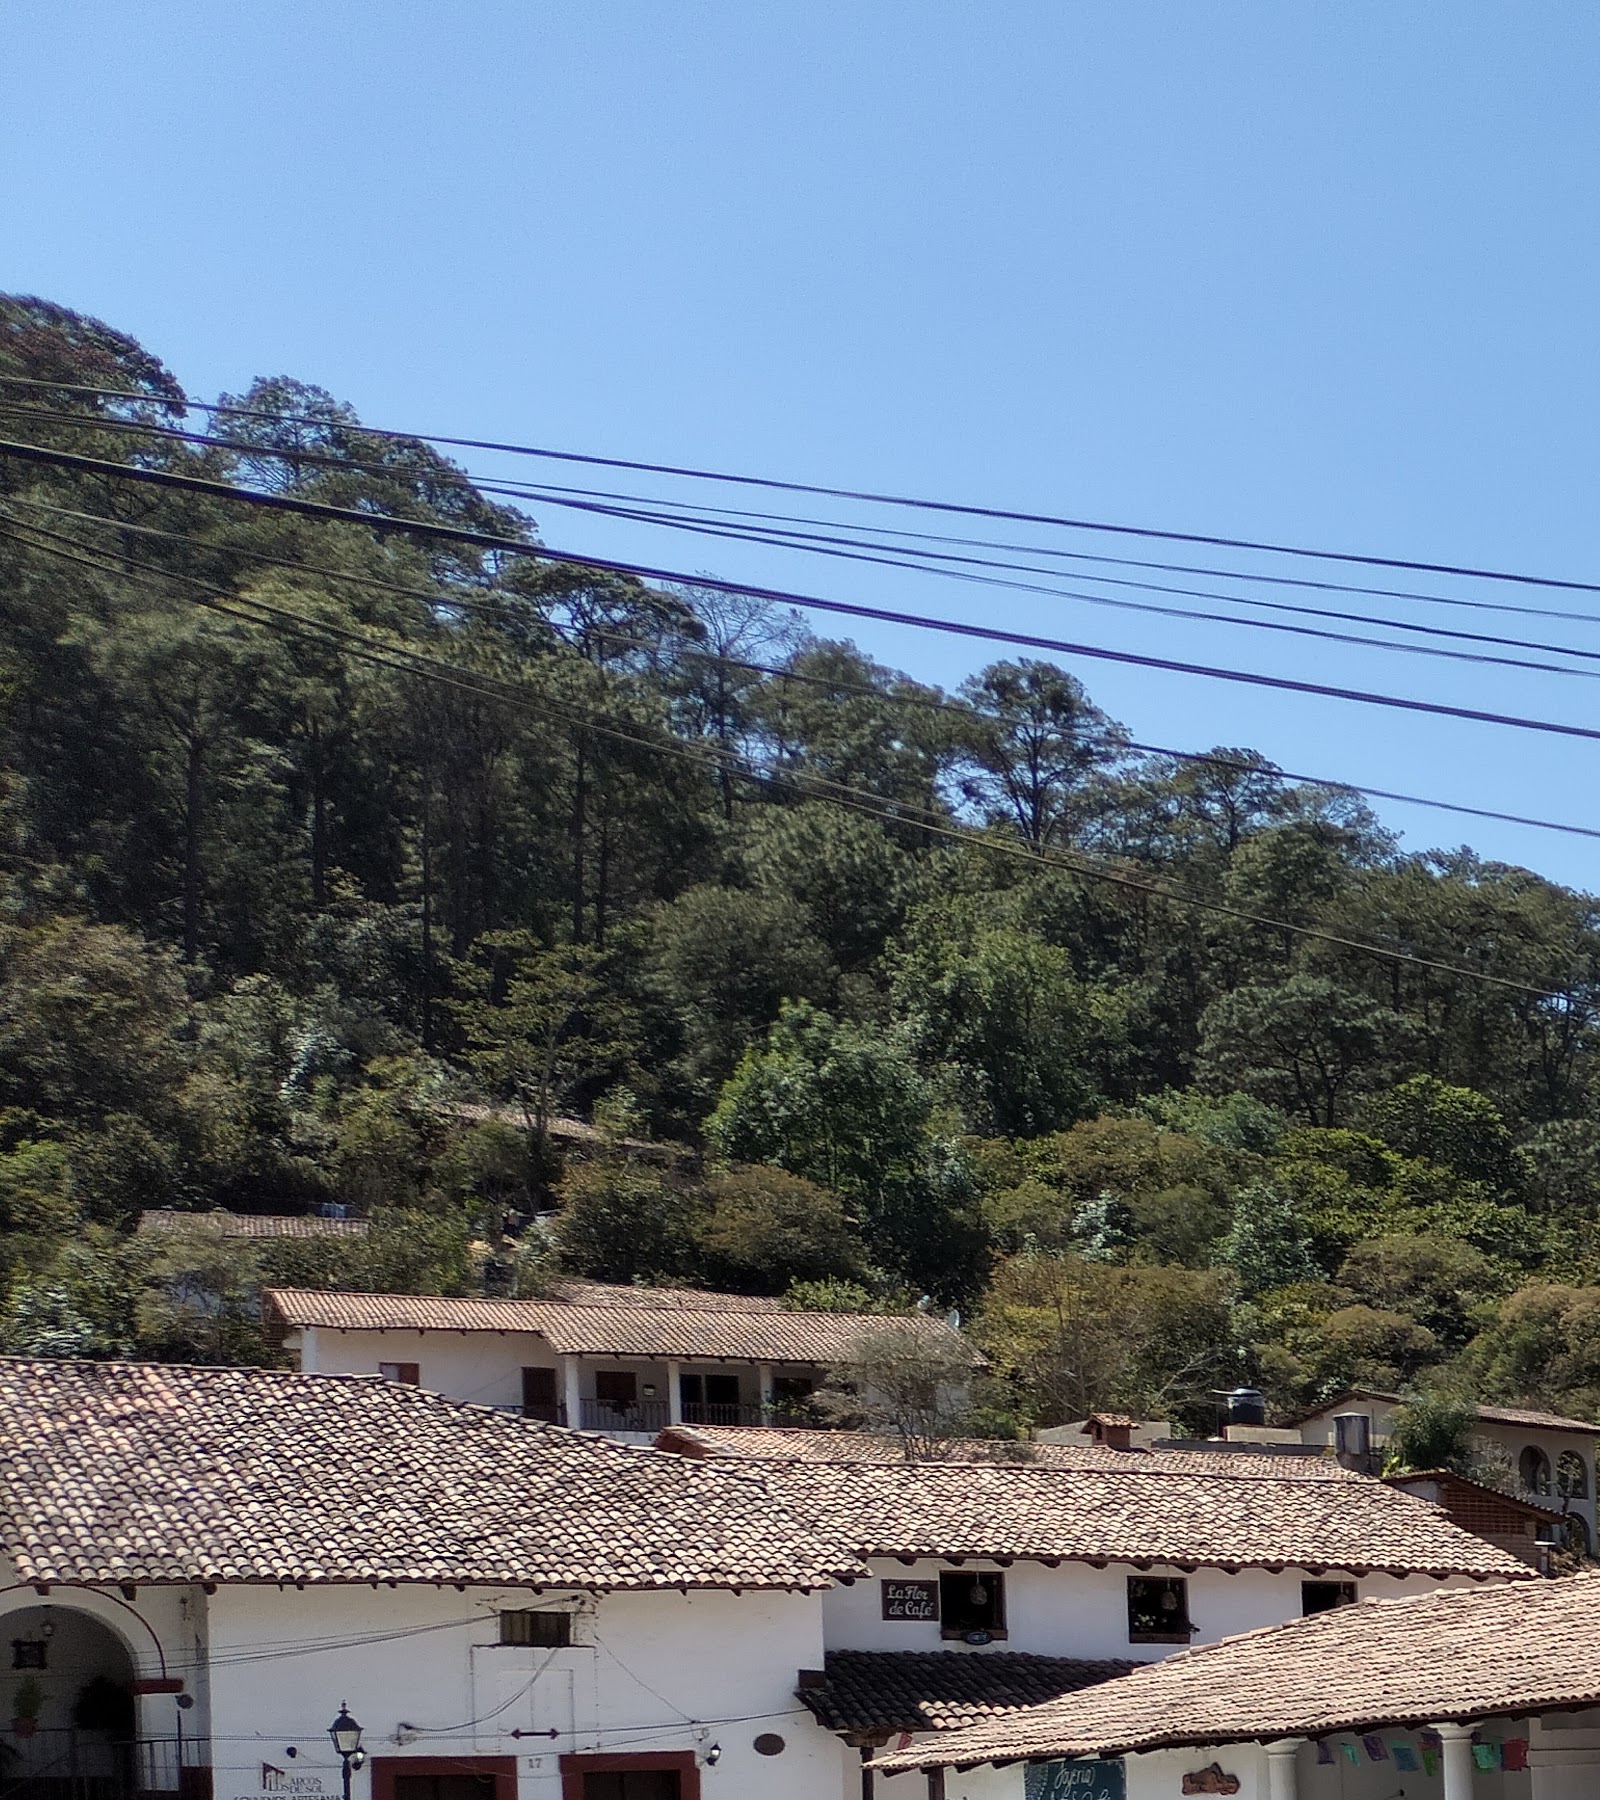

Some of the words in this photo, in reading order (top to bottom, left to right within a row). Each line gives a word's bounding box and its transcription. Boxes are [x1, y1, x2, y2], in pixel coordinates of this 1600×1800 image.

[887, 1584, 904, 1600] La
[905, 1585, 929, 1600] Flor
[889, 1601, 903, 1616] de
[905, 1601, 935, 1618] Café
[528, 1758, 542, 1769] 17
